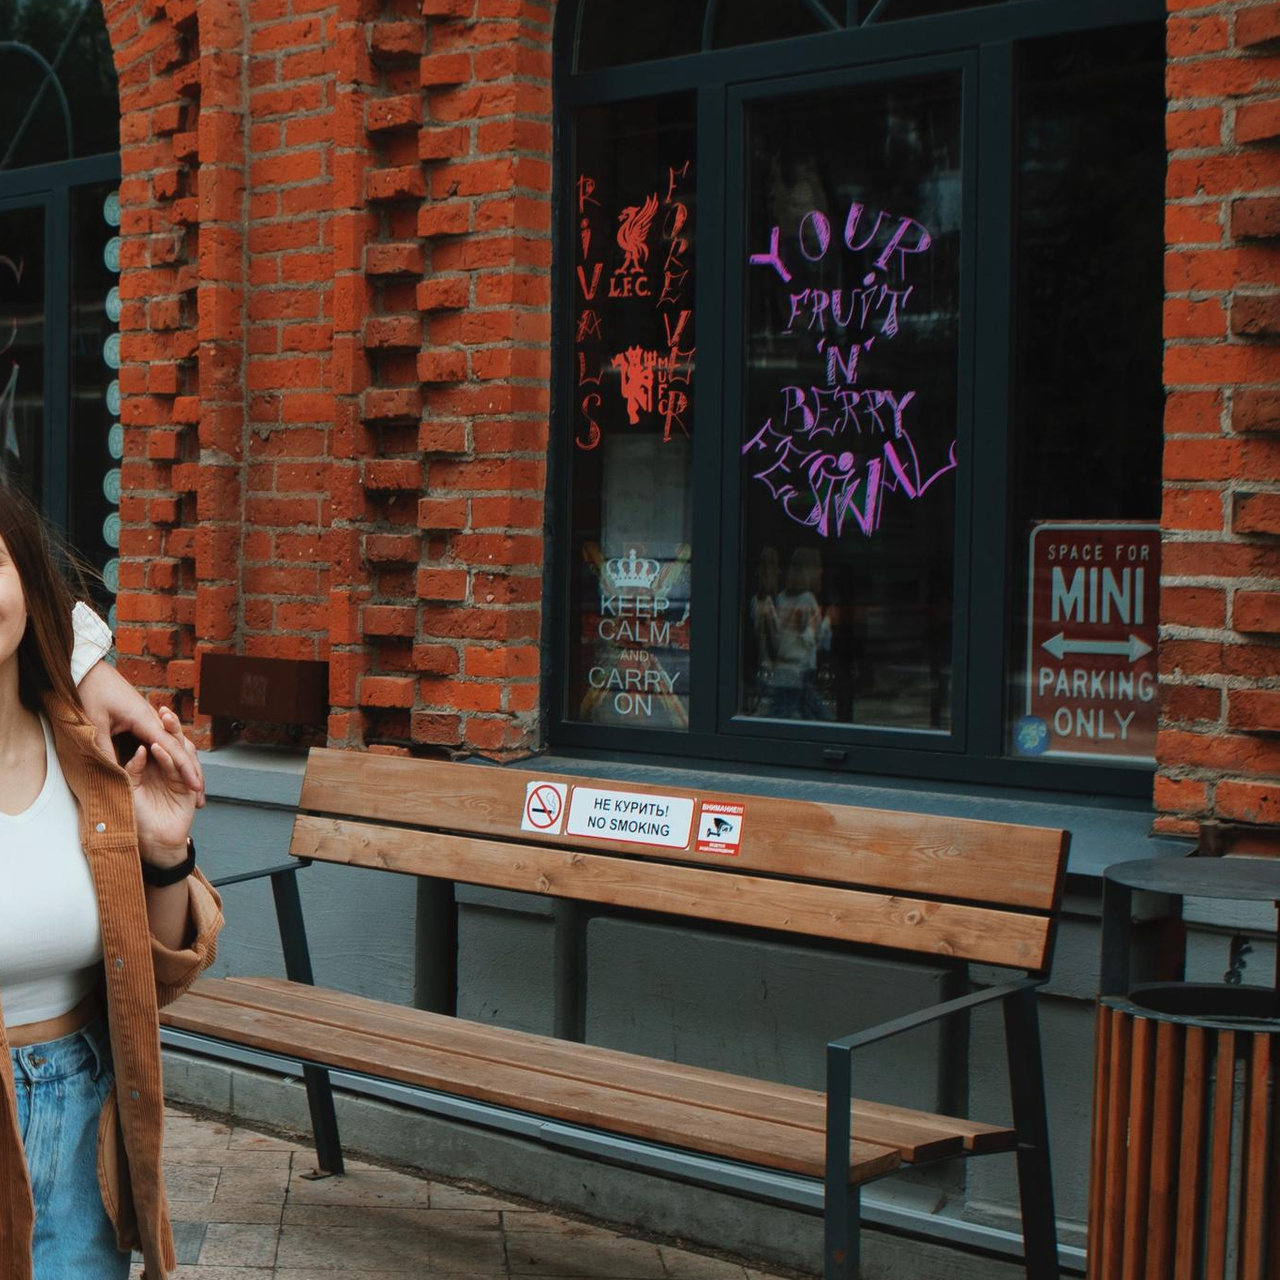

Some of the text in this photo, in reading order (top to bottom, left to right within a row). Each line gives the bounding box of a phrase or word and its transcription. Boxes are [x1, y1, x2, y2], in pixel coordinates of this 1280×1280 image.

[749, 202, 932, 283] YOUR
[781, 386, 916, 441] BERRY
[1048, 544, 1150, 561] SPACE FOR
[600, 594, 670, 618] KEEP
[1051, 566, 1145, 625] MINI
[598, 620, 671, 645] CALM
[620, 650, 650, 663] AND
[588, 667, 681, 694] CARRY
[1038, 667, 1155, 702] PARKING
[614, 692, 652, 717] ON
[1053, 706, 1136, 741] ONLY
[594, 798, 670, 818] НЕ КУРИТЬ!
[587, 815, 671, 837] NO SMOKING
